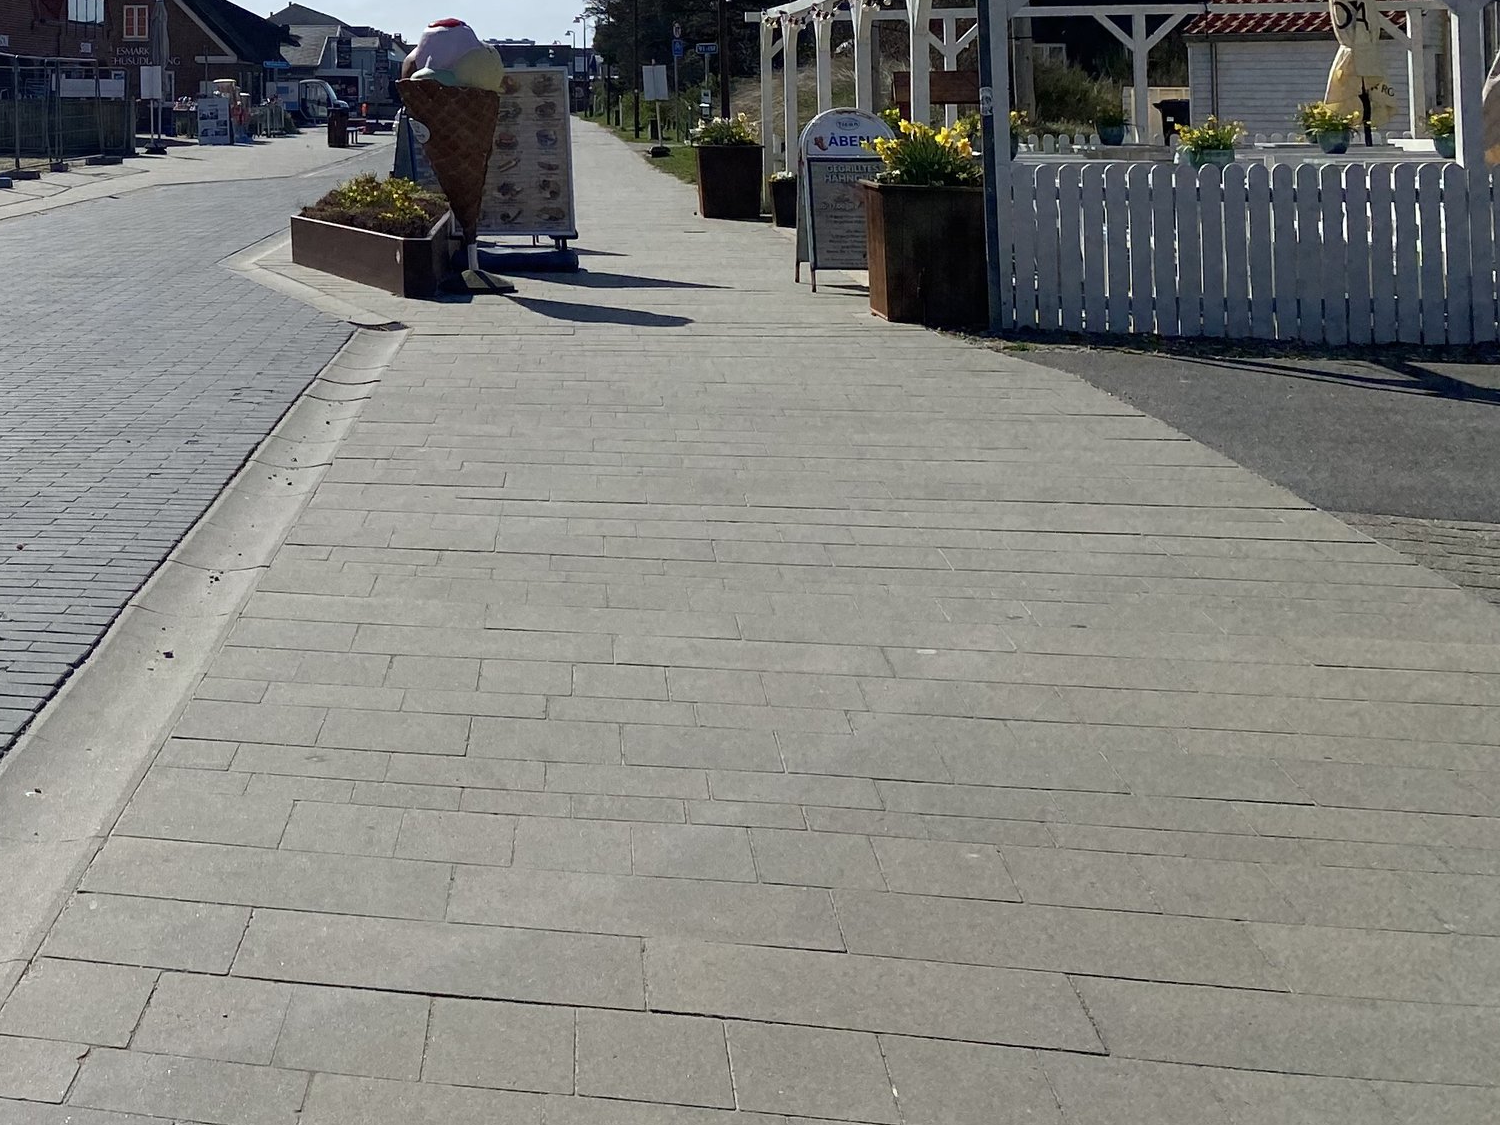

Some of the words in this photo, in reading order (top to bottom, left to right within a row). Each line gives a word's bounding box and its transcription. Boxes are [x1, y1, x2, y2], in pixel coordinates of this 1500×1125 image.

[116, 47, 150, 55] ESMARK
[114, 57, 181, 65] HUSUDLNG
[828, 132, 870, 147] ÅBEN
[827, 165, 879, 173] GEGRILLTES
